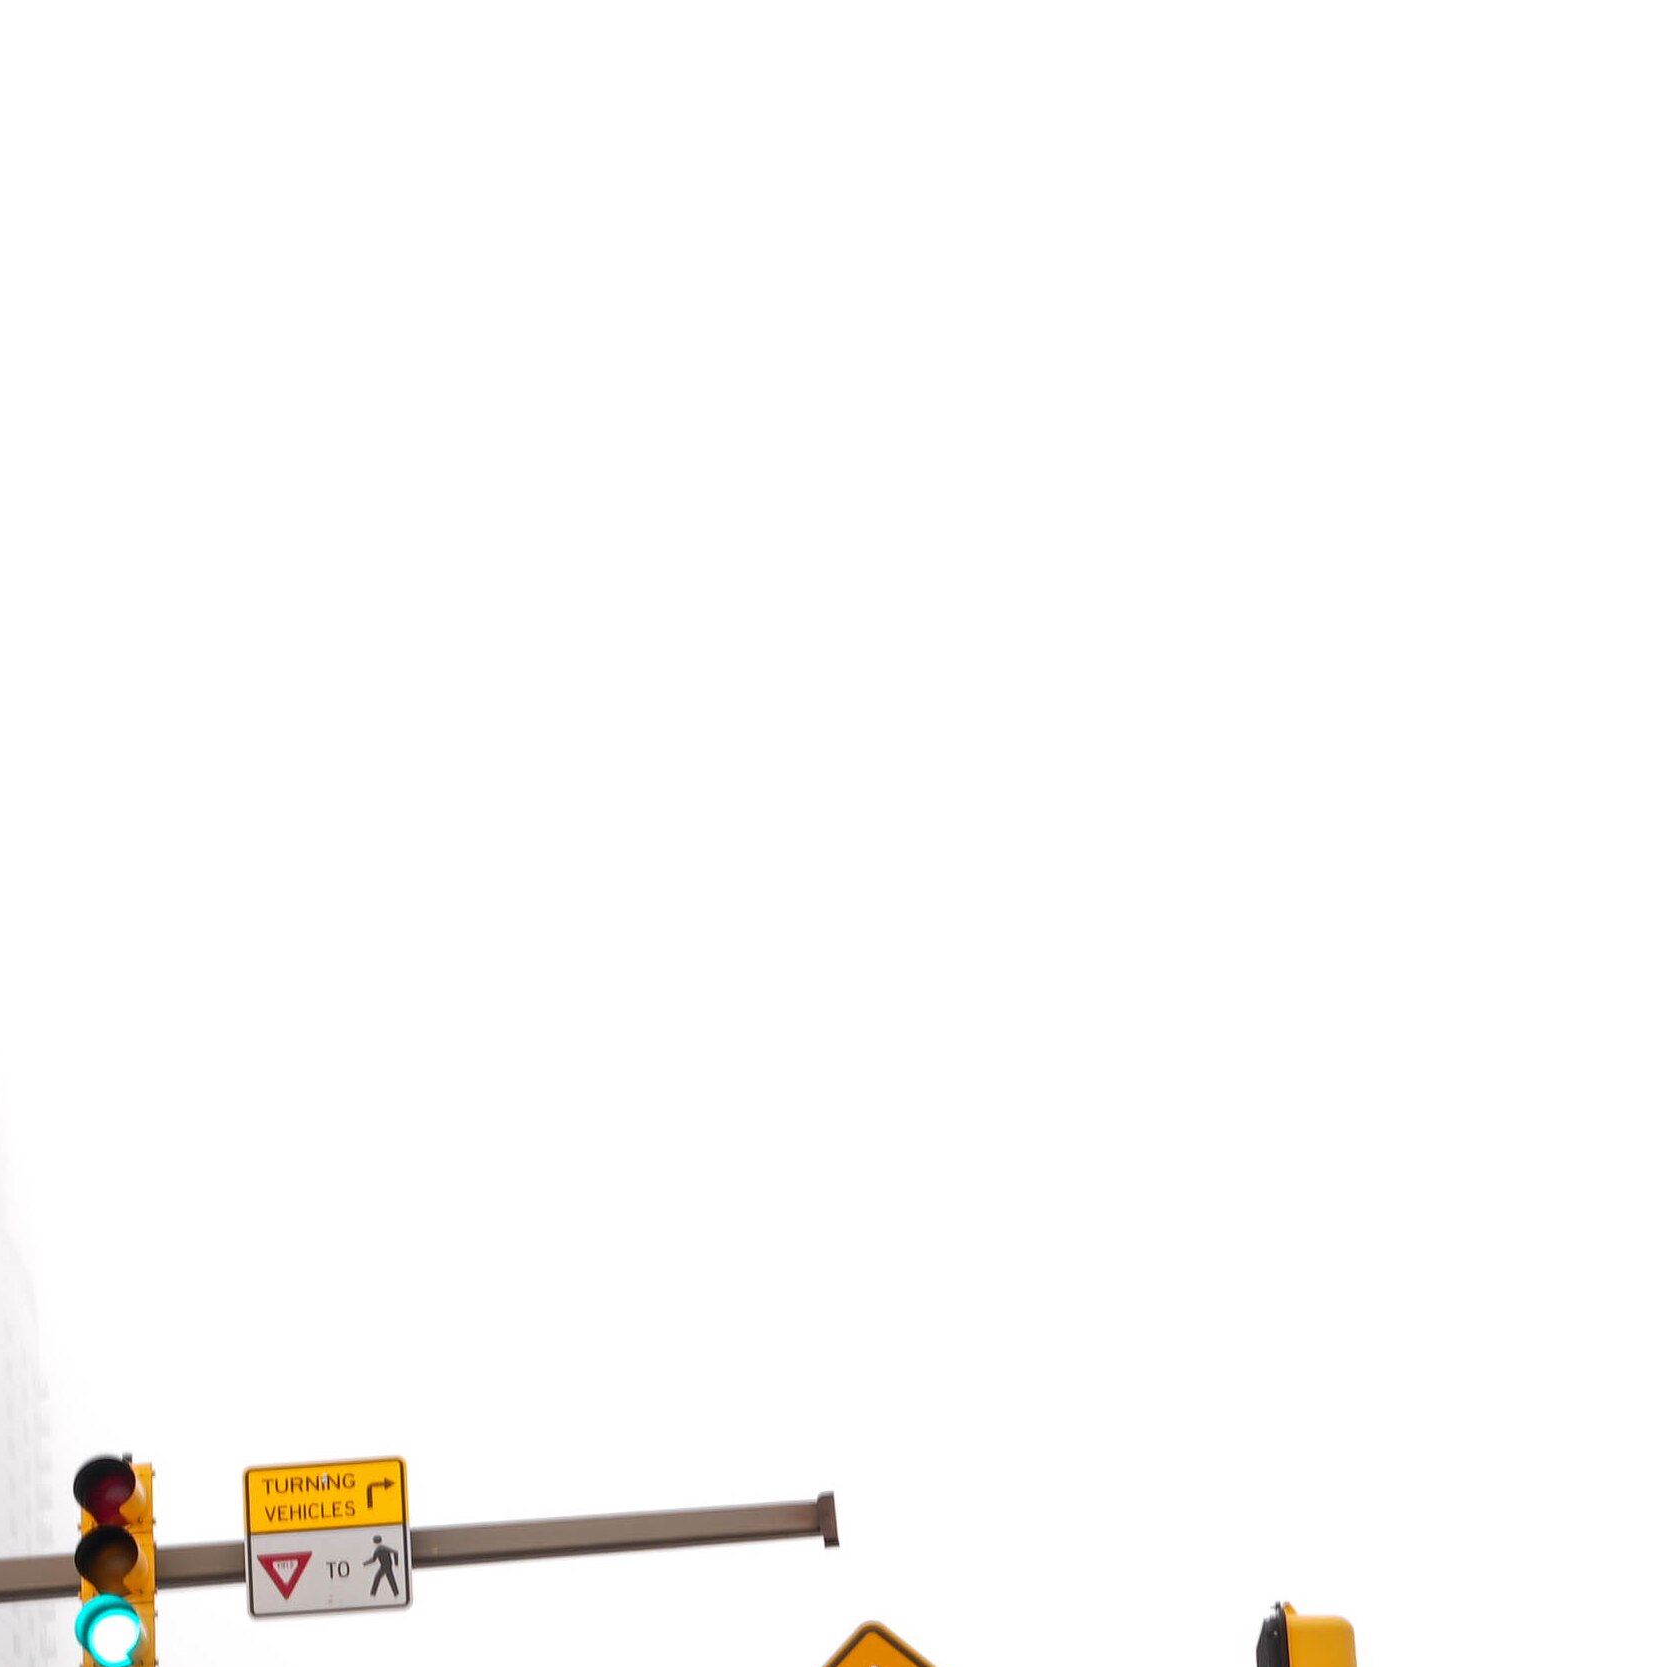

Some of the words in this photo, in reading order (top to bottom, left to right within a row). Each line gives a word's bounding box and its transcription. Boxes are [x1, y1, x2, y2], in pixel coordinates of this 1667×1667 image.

[261, 1472, 356, 1495] TURNING
[265, 1500, 356, 1523] VEHICLES
[325, 1560, 351, 1579] TO
